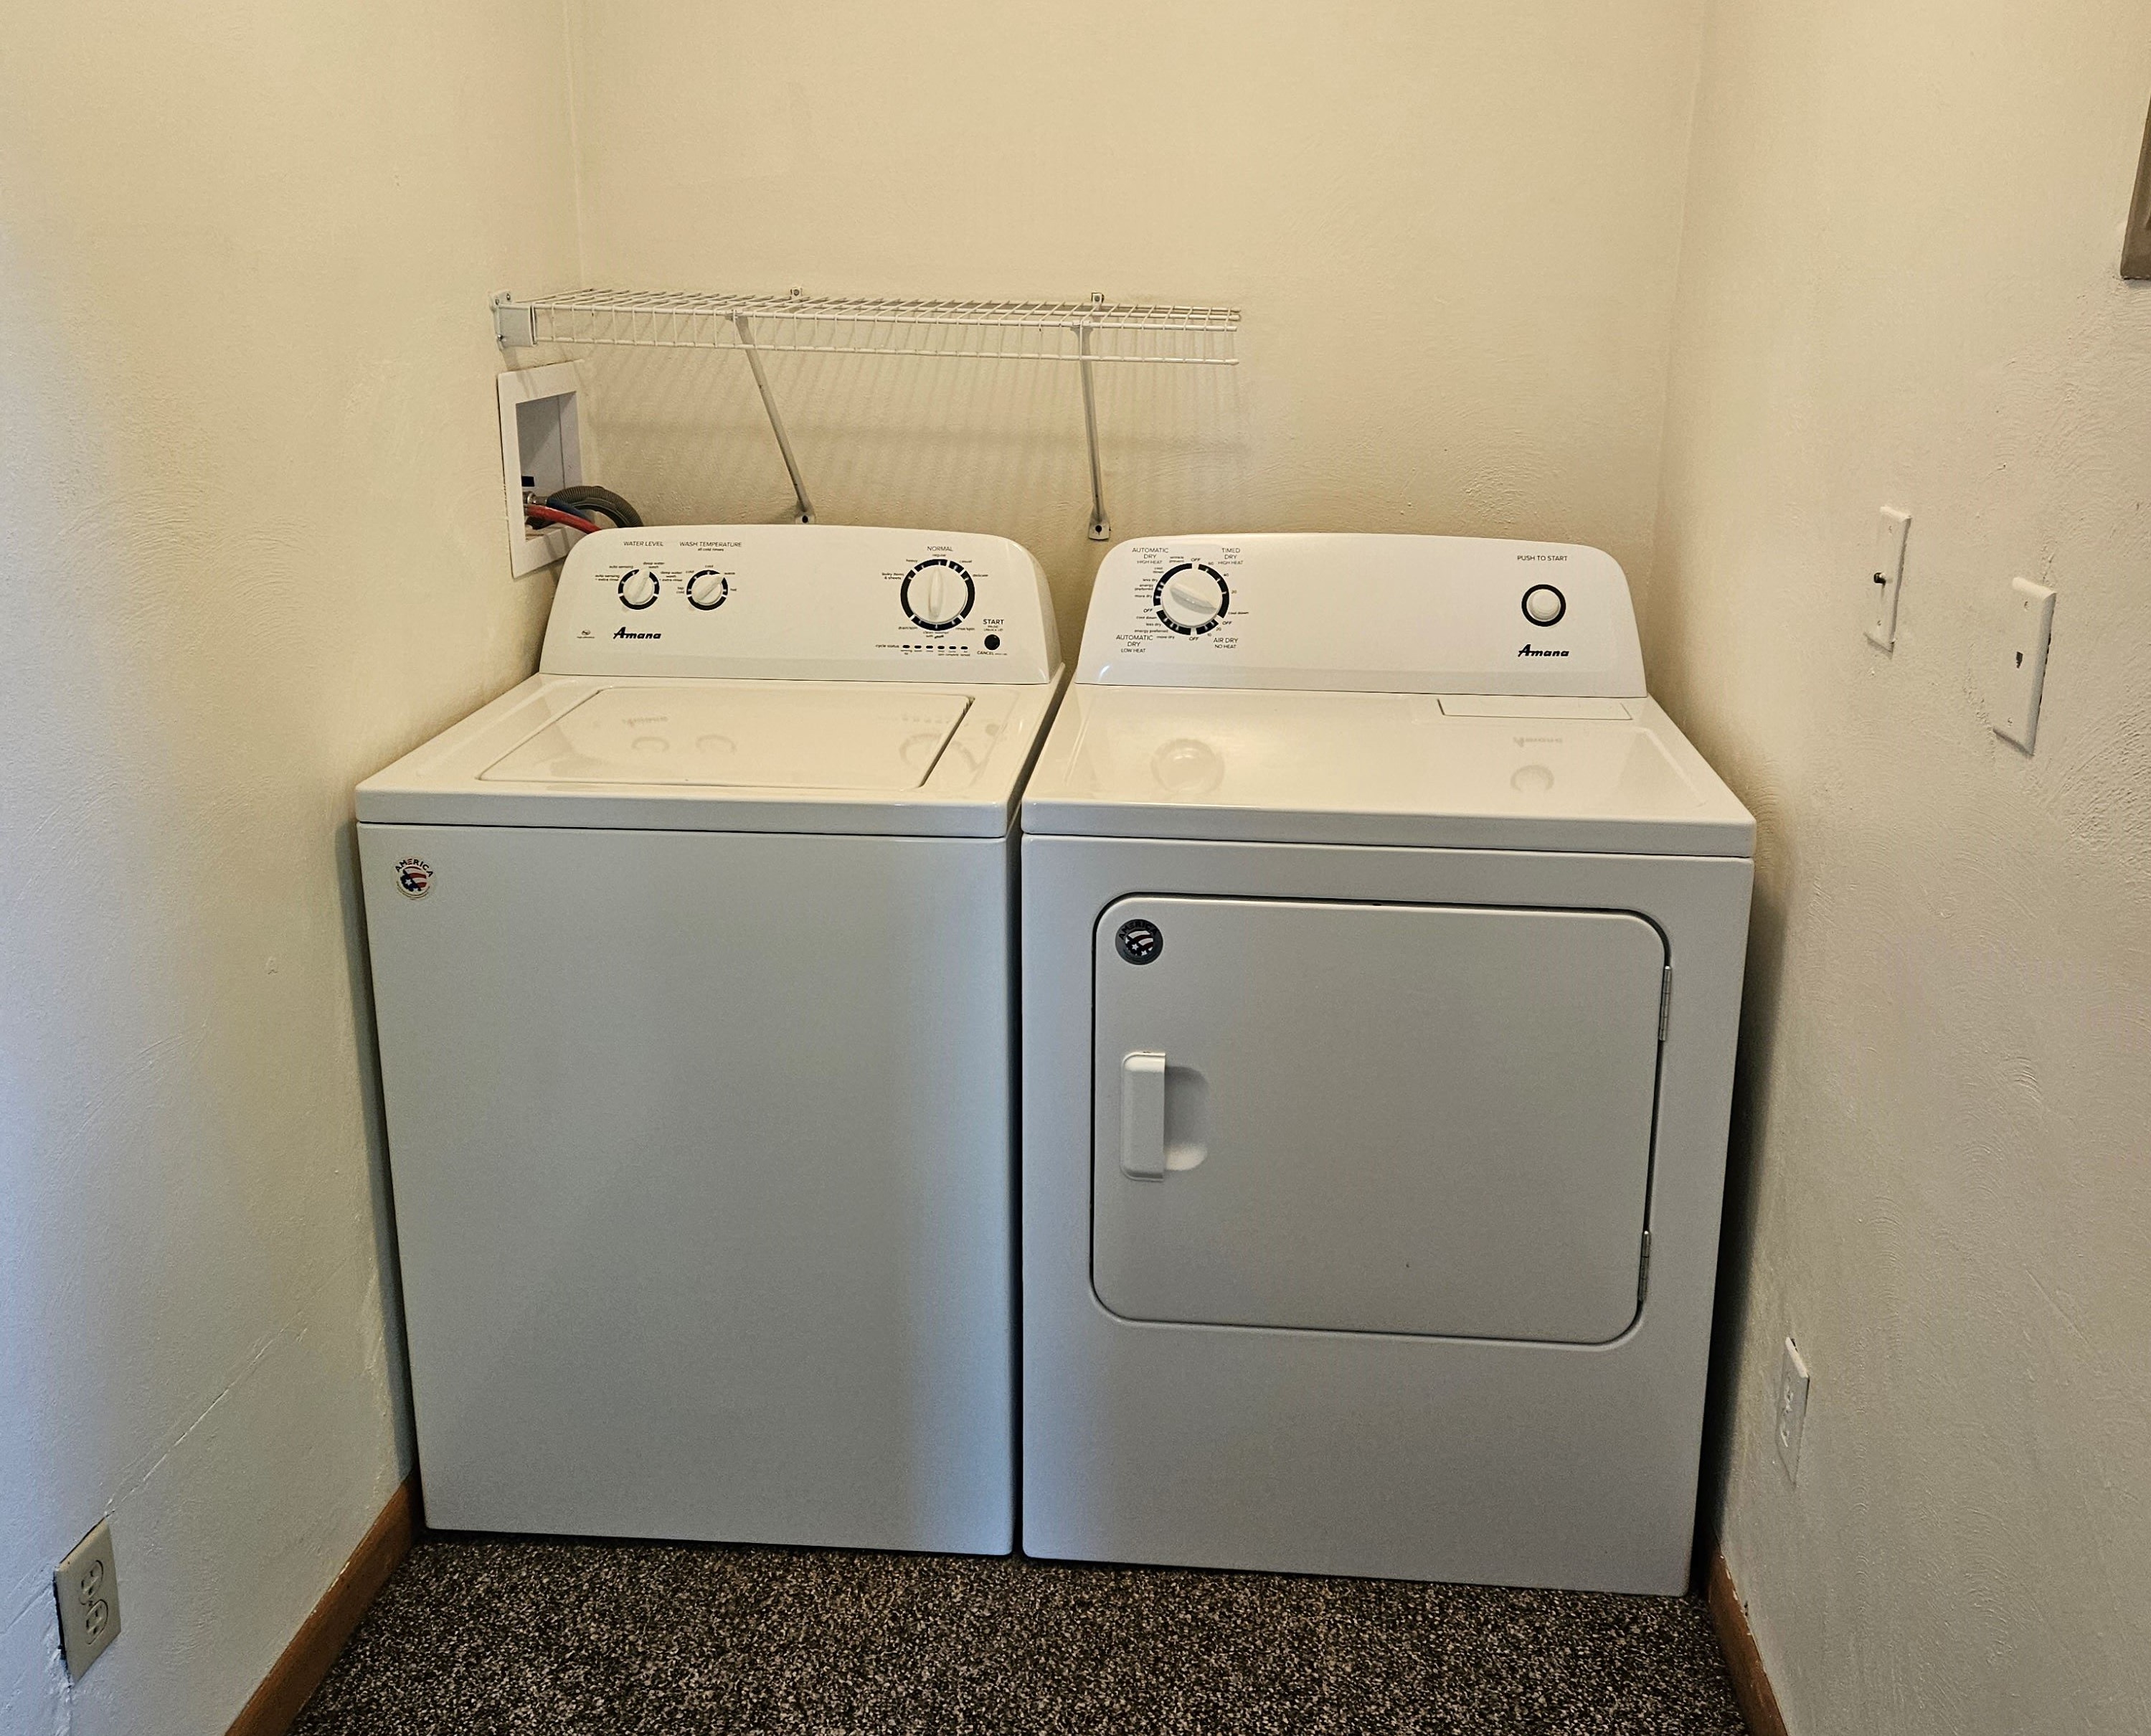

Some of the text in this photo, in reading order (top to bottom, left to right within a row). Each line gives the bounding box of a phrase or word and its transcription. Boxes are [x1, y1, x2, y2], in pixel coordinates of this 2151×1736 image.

[613, 626, 661, 640] Amana
[1518, 643, 1569, 657] Amana
[395, 858, 433, 877] AMERICA
[1118, 921, 1158, 941] AMERICA
